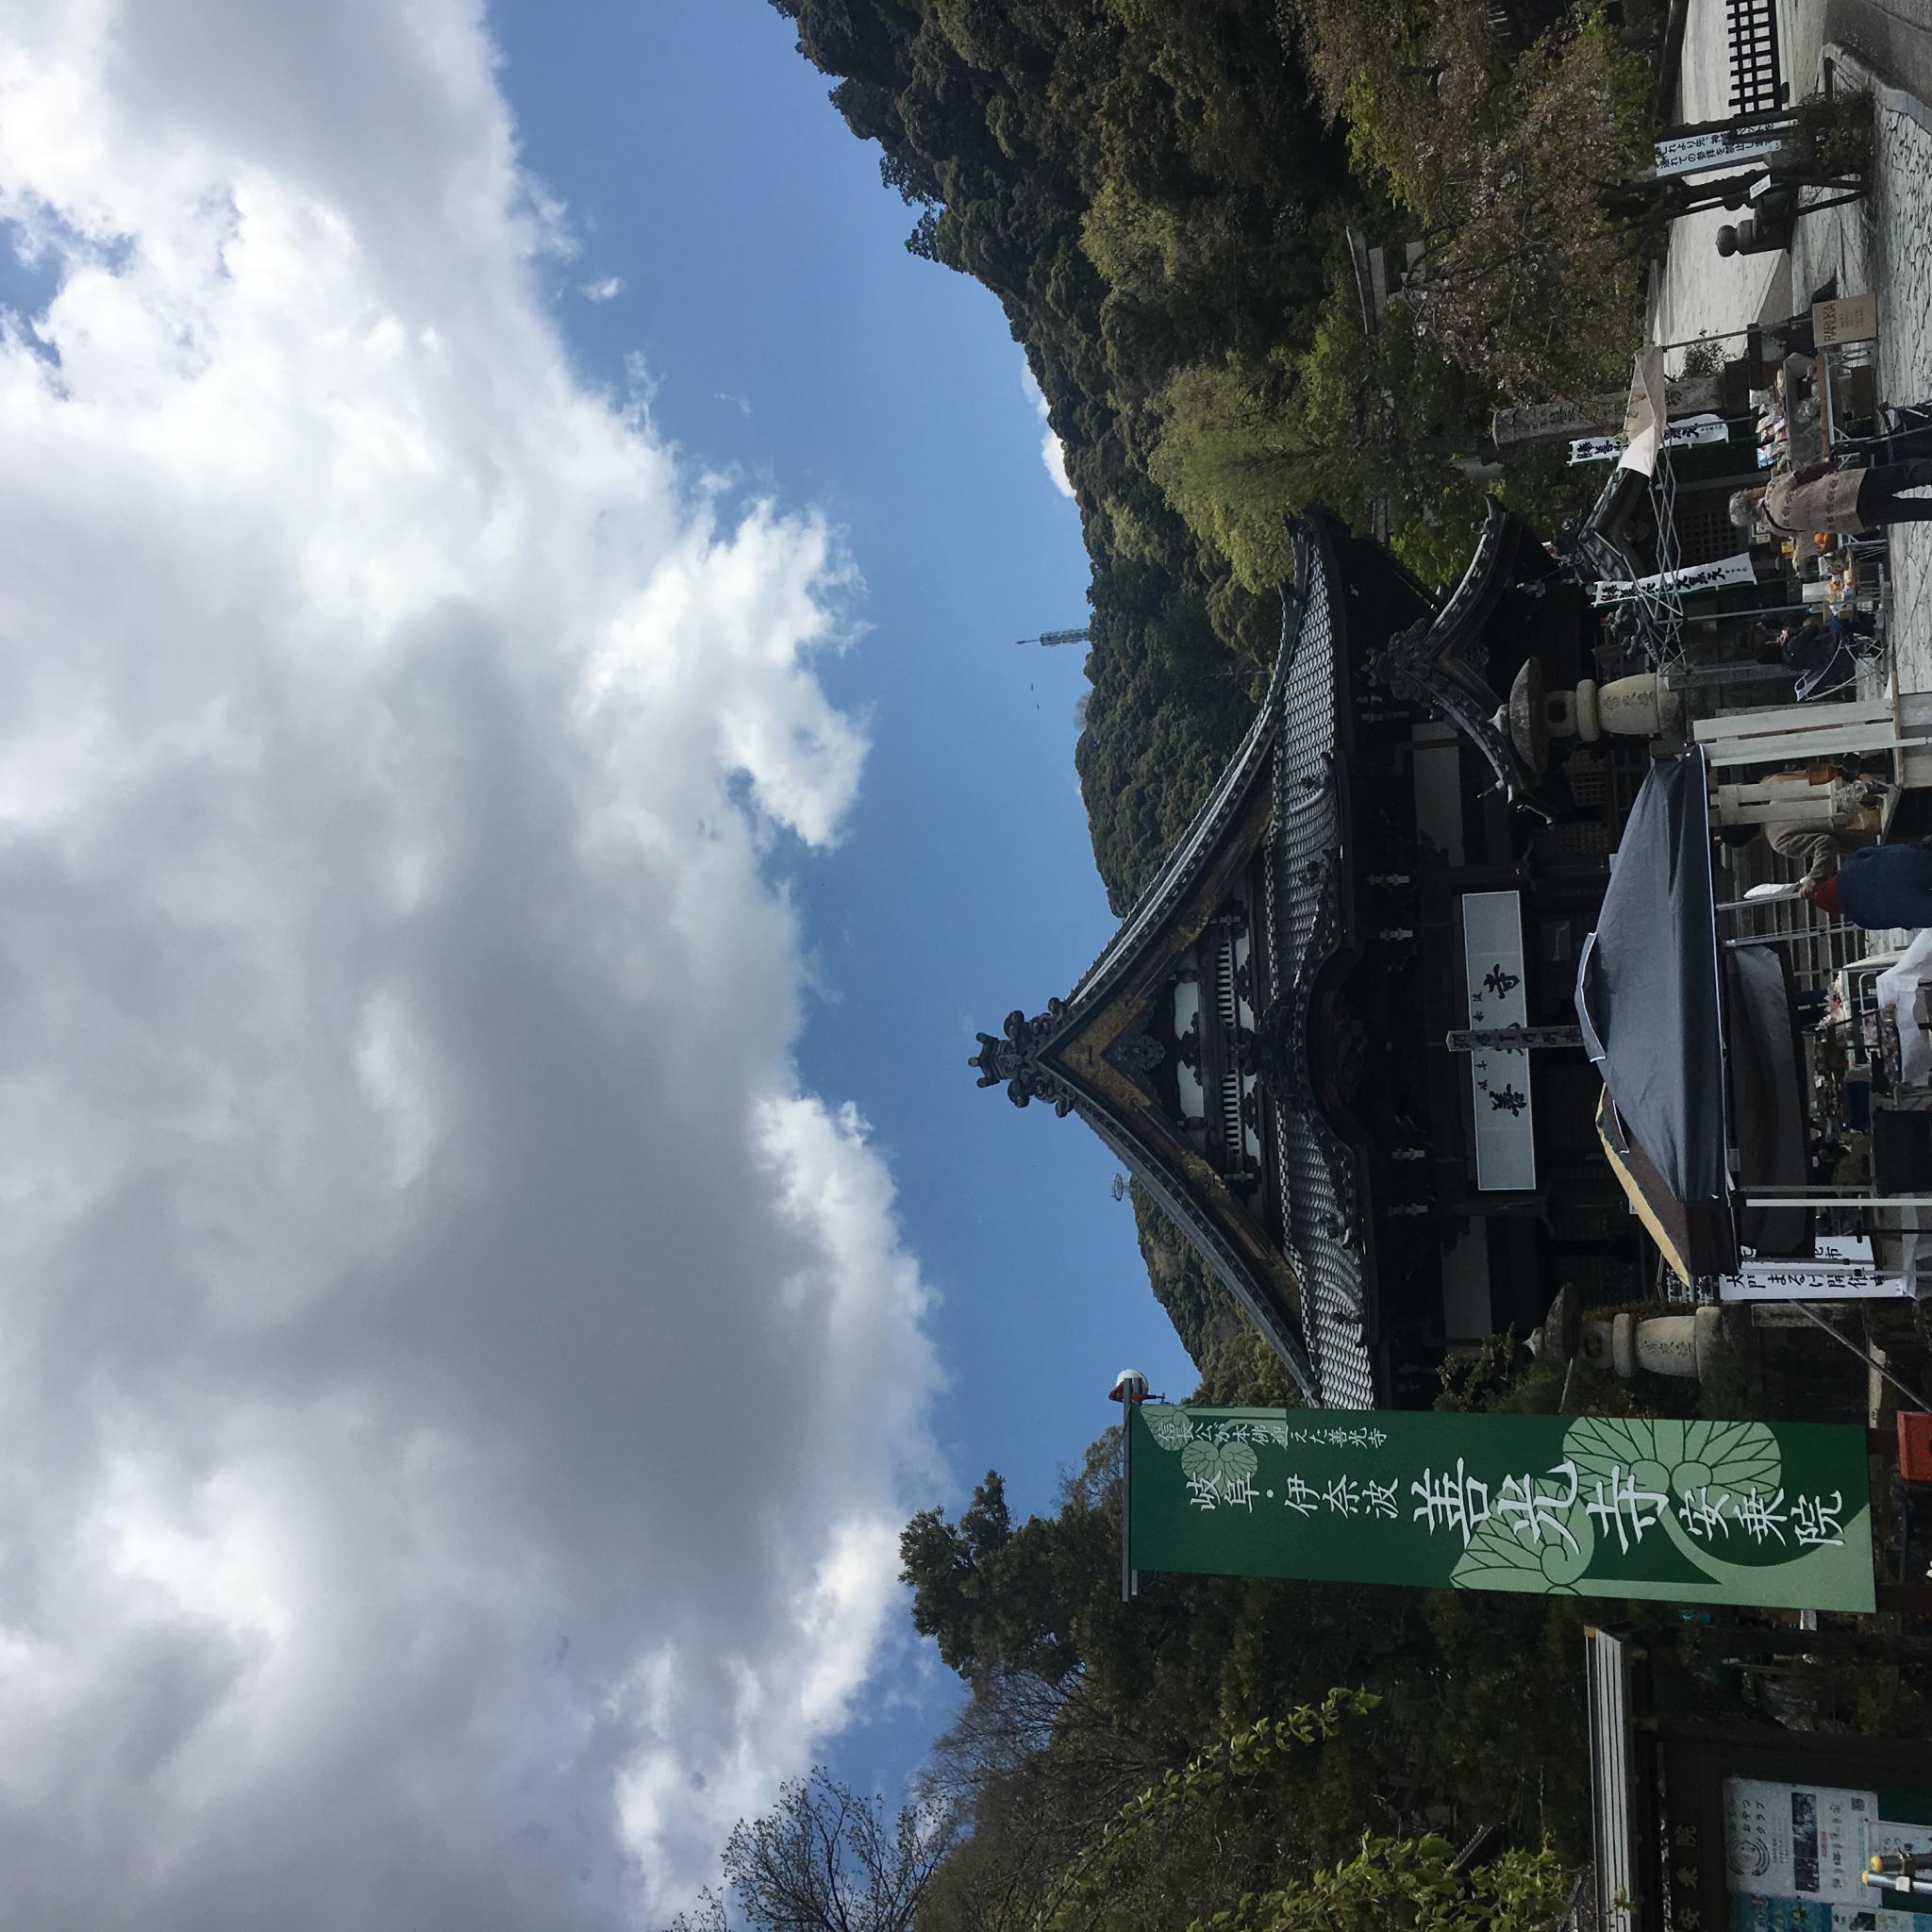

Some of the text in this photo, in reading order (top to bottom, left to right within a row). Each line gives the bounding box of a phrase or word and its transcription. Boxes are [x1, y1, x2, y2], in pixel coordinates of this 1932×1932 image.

[1157, 1423, 1387, 1449] 信長公が本佛迎えた善光寺
[1410, 1457, 1668, 1555] 善光寺
[1679, 1487, 1845, 1546] 安乗院
